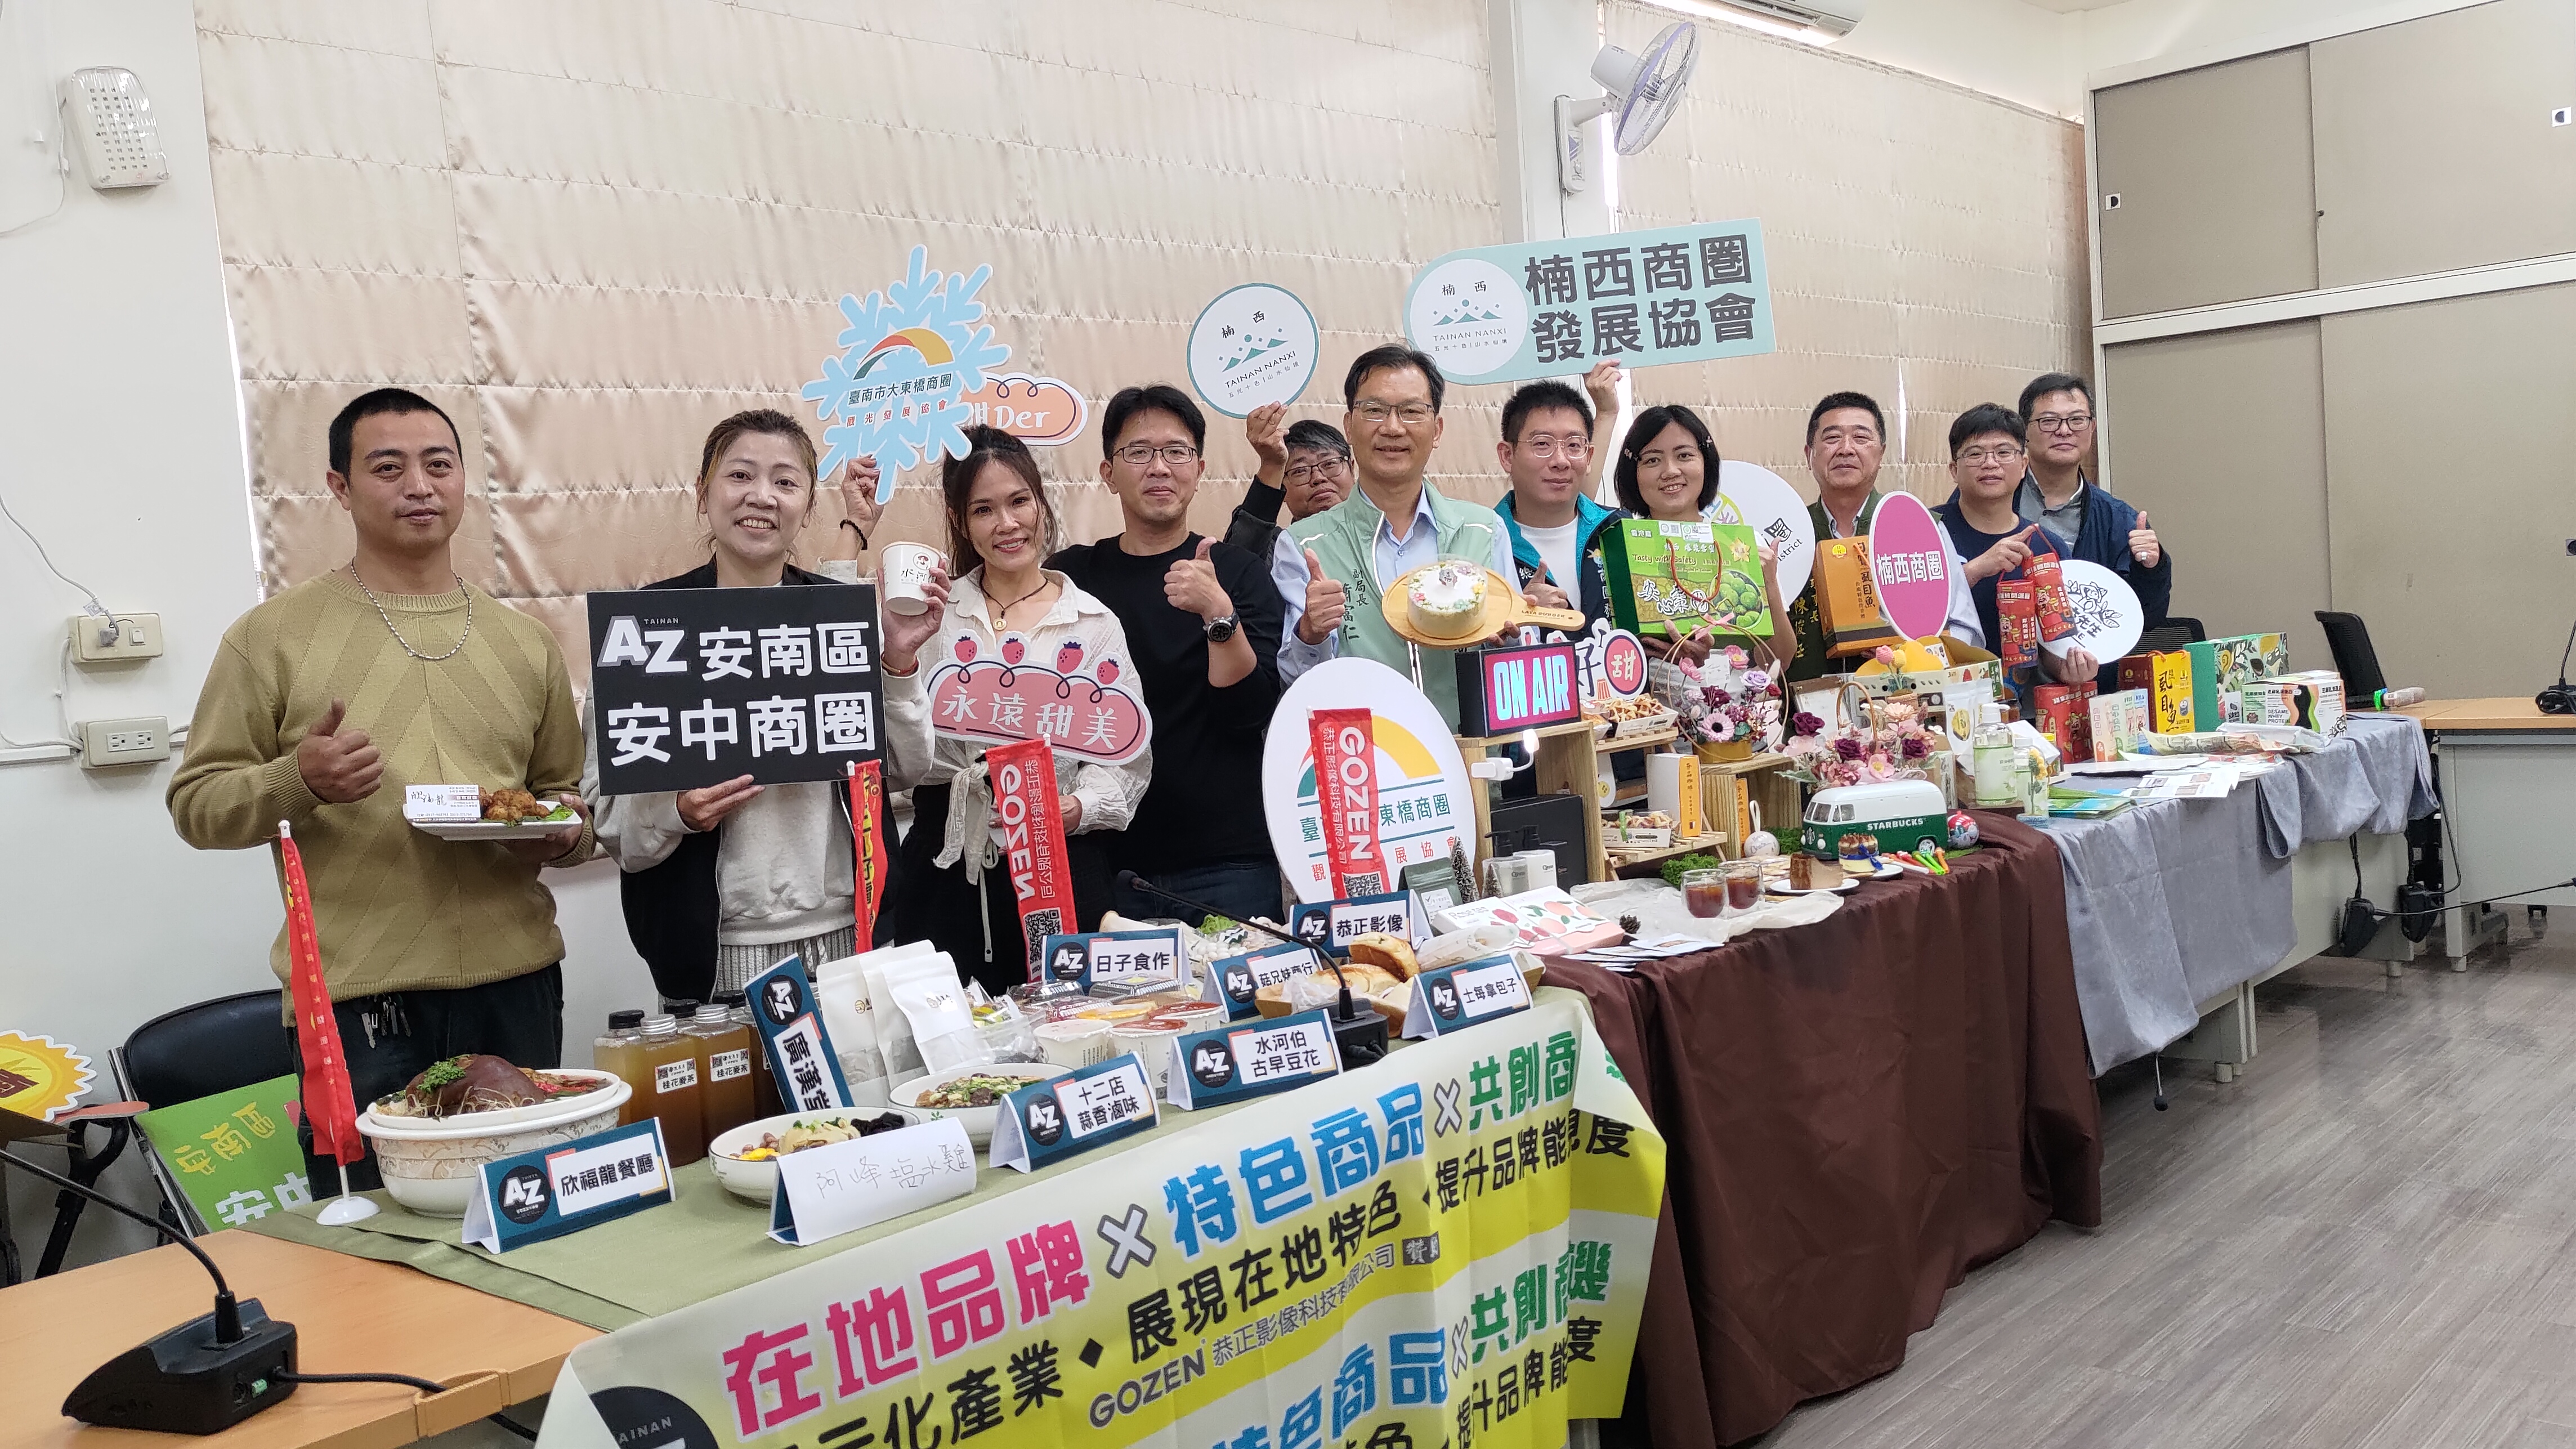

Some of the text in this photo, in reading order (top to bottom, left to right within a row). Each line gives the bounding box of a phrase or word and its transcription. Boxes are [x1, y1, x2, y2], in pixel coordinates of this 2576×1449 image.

[1524, 234, 1752, 306] 楠西商圈
[1442, 281, 1486, 297] 楠西
[1221, 311, 1264, 338] 楠西
[1433, 328, 1506, 342] TAINAN NANXI
[1532, 292, 1756, 363] 發展協會
[1225, 350, 1296, 388] TAINAN NANXI
[848, 373, 951, 405] 臺南市大東橋商圈
[847, 400, 947, 427] 觀光發展協會
[1632, 554, 1652, 563] Tasty
[1777, 538, 1803, 562] istrict
[1876, 551, 1944, 585] 楠西商圈
[1353, 569, 1369, 606] 副局長
[598, 616, 687, 674] AZ
[699, 621, 871, 681] 安南區
[1612, 650, 1636, 681] 甜
[1493, 655, 1570, 721] ON AIR
[607, 692, 875, 766] 安中商圈
[941, 686, 1117, 750] 永遠甜美
[1339, 727, 1374, 860] GOZEN
[1299, 793, 1451, 843] 臺東橋商圈
[1867, 817, 1924, 830] STARBUCKS
[1299, 915, 1326, 936] AZ
[1336, 914, 1403, 938] 恭正影像
[1053, 949, 1084, 970] AZ
[1097, 952, 1170, 973] 日子食作
[1227, 972, 1252, 992] AZ
[1433, 984, 1459, 1009] AZ
[1255, 1031, 1307, 1054] 水河伯
[1195, 1049, 1230, 1071] AZ
[1250, 1049, 1321, 1077] 古早豆花
[1078, 1075, 1126, 1106] 十二店
[1029, 1105, 1062, 1130] AZ
[1077, 1096, 1140, 1132] 蒜香滷味
[561, 1153, 655, 1197] 欣福龍餐廳
[503, 1177, 545, 1208] AZ
[723, 1220, 1090, 1435] 在地品牌
[1164, 1083, 1425, 1254] 特色商品
[1128, 1180, 1401, 1363] 展現在地特色
[1089, 1348, 1206, 1428] GOZEN
[1212, 1243, 1395, 1367] 恭正影像科技有限公司
[1457, 1316, 1603, 1449] 提升品牌能度
[619, 1416, 673, 1443] AINAN
